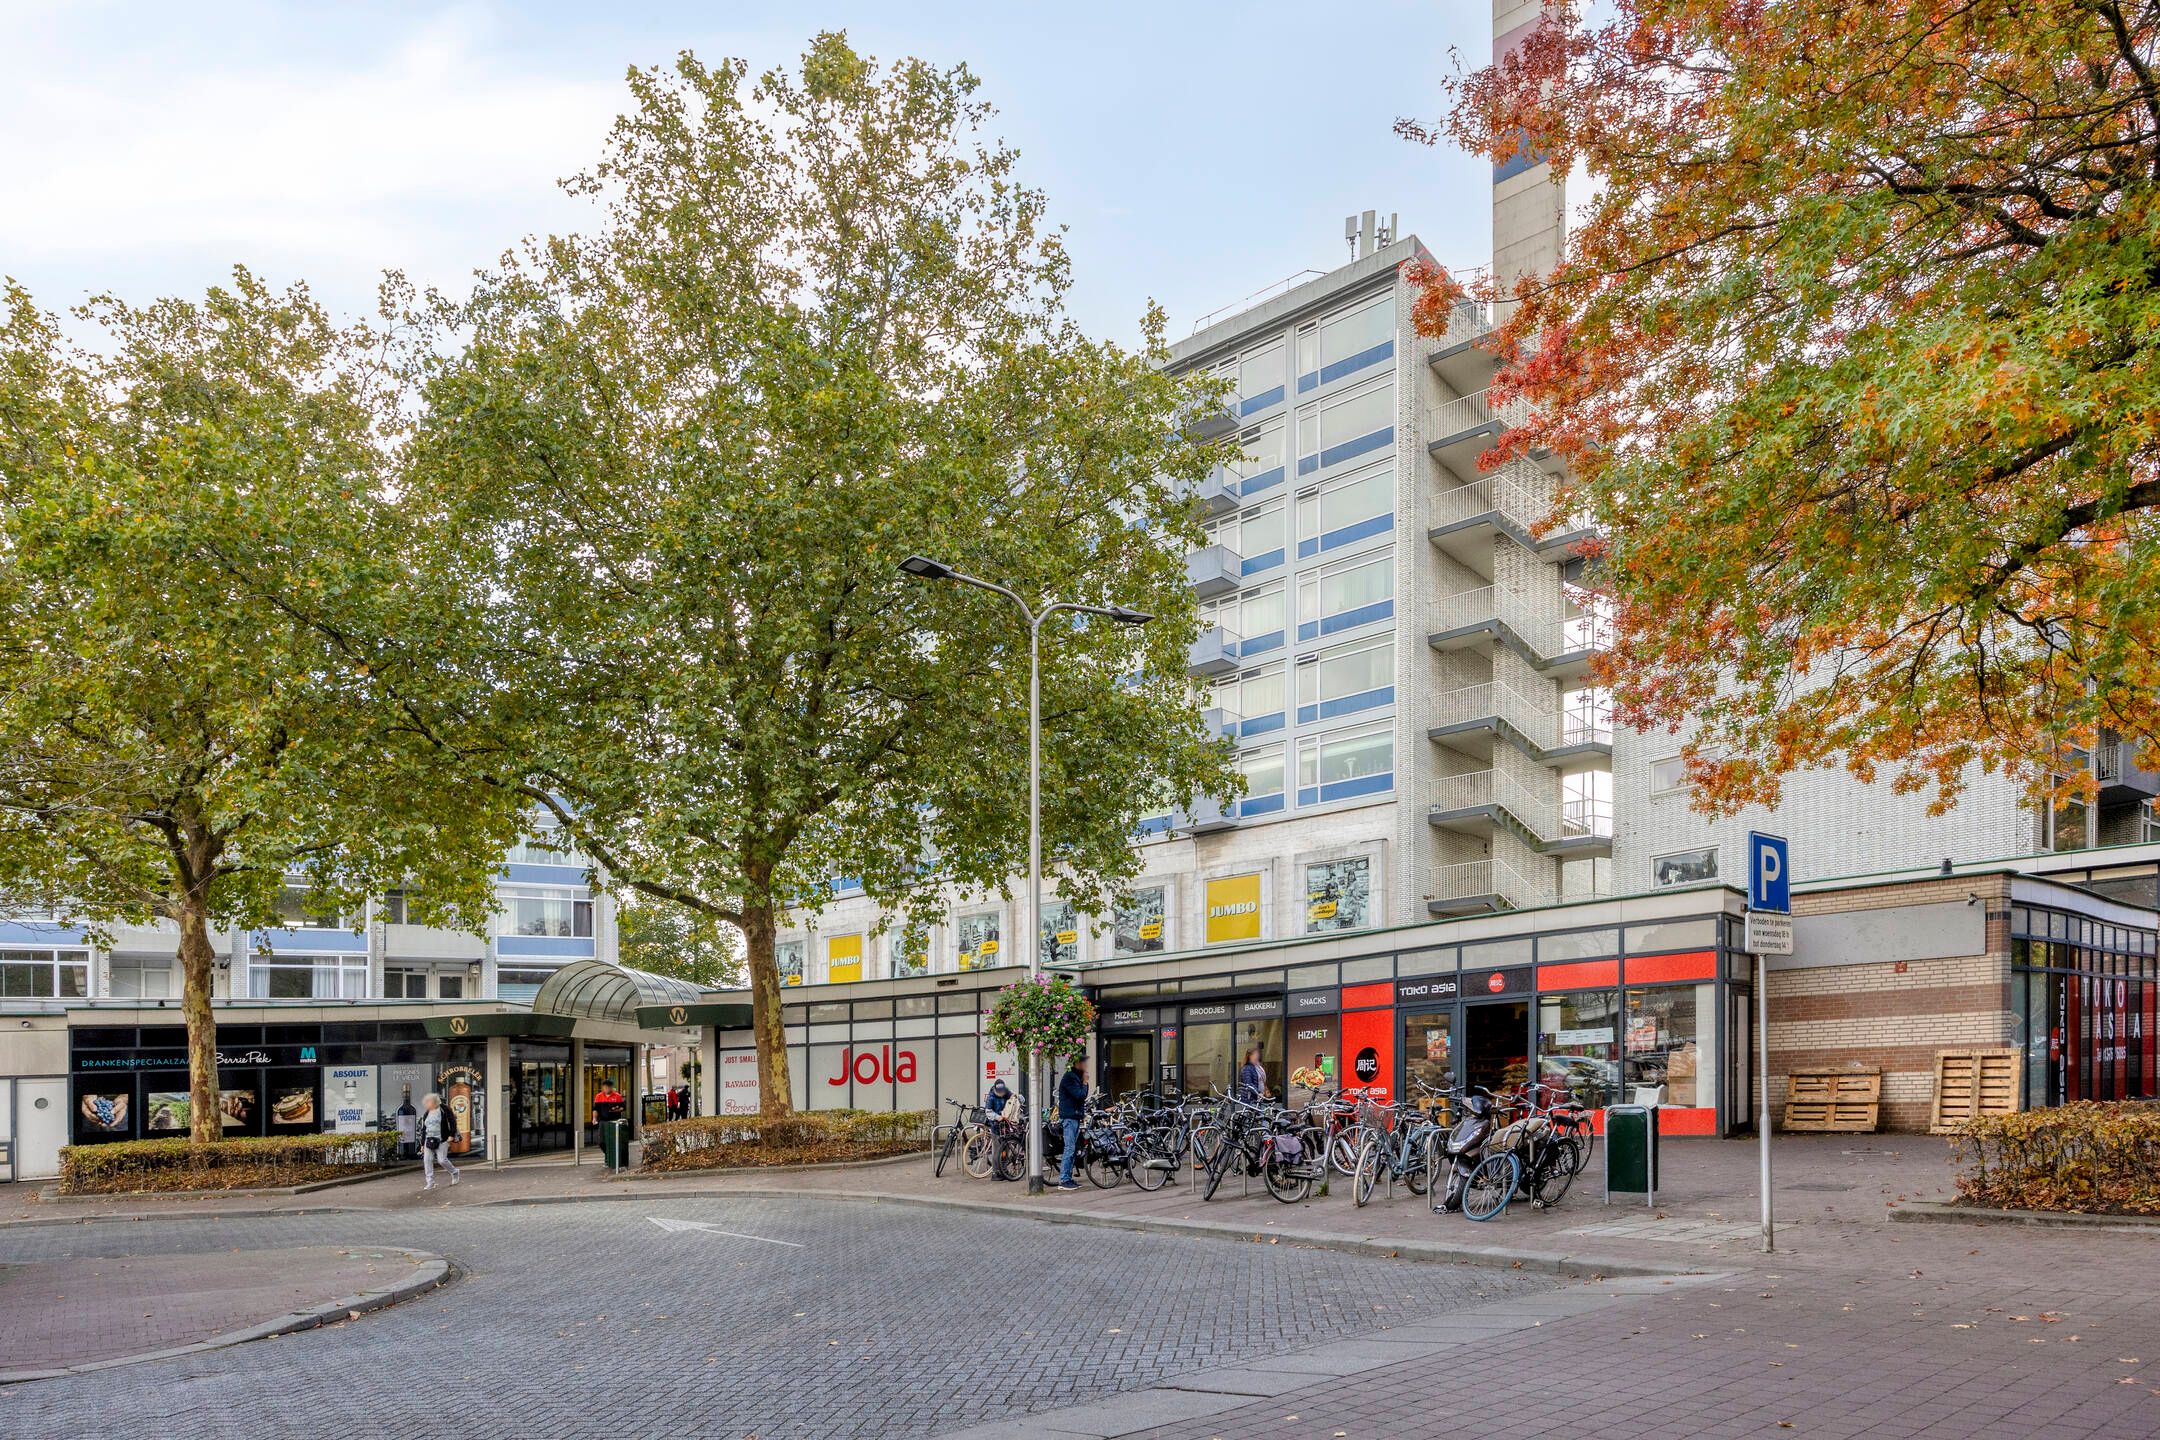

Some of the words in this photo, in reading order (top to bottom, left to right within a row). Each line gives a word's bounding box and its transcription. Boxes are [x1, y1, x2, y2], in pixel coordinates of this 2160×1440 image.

[1760, 844, 1781, 901] P
[1209, 901, 1257, 919] JUMBO
[831, 954, 860, 968] JUMBO
[1399, 985, 1428, 996] TOKO
[2083, 977, 2125, 1008] TOKO
[1244, 1001, 1276, 1012] BAKKERIJ
[1300, 996, 1327, 1006] SNACKS
[1114, 1010, 1144, 1020] HIZMET
[1189, 1006, 1225, 1016] BROODJES
[2095, 1012, 2141, 1040] ASIA
[1298, 1029, 1328, 1040] HIZMET
[81, 1057, 190, 1067] DRANKENSPECIAALZAA
[724, 1055, 738, 1064] JUST
[828, 1044, 917, 1086] Jola
[1357, 1059, 1377, 1073] 周记
[333, 1069, 369, 1078] ABSOLUT.
[725, 1079, 757, 1088] RAVAGIO
[337, 1108, 363, 1116] ABSOLUT
[724, 1099, 758, 1114] Persival
[339, 1114, 361, 1122] VODKA
